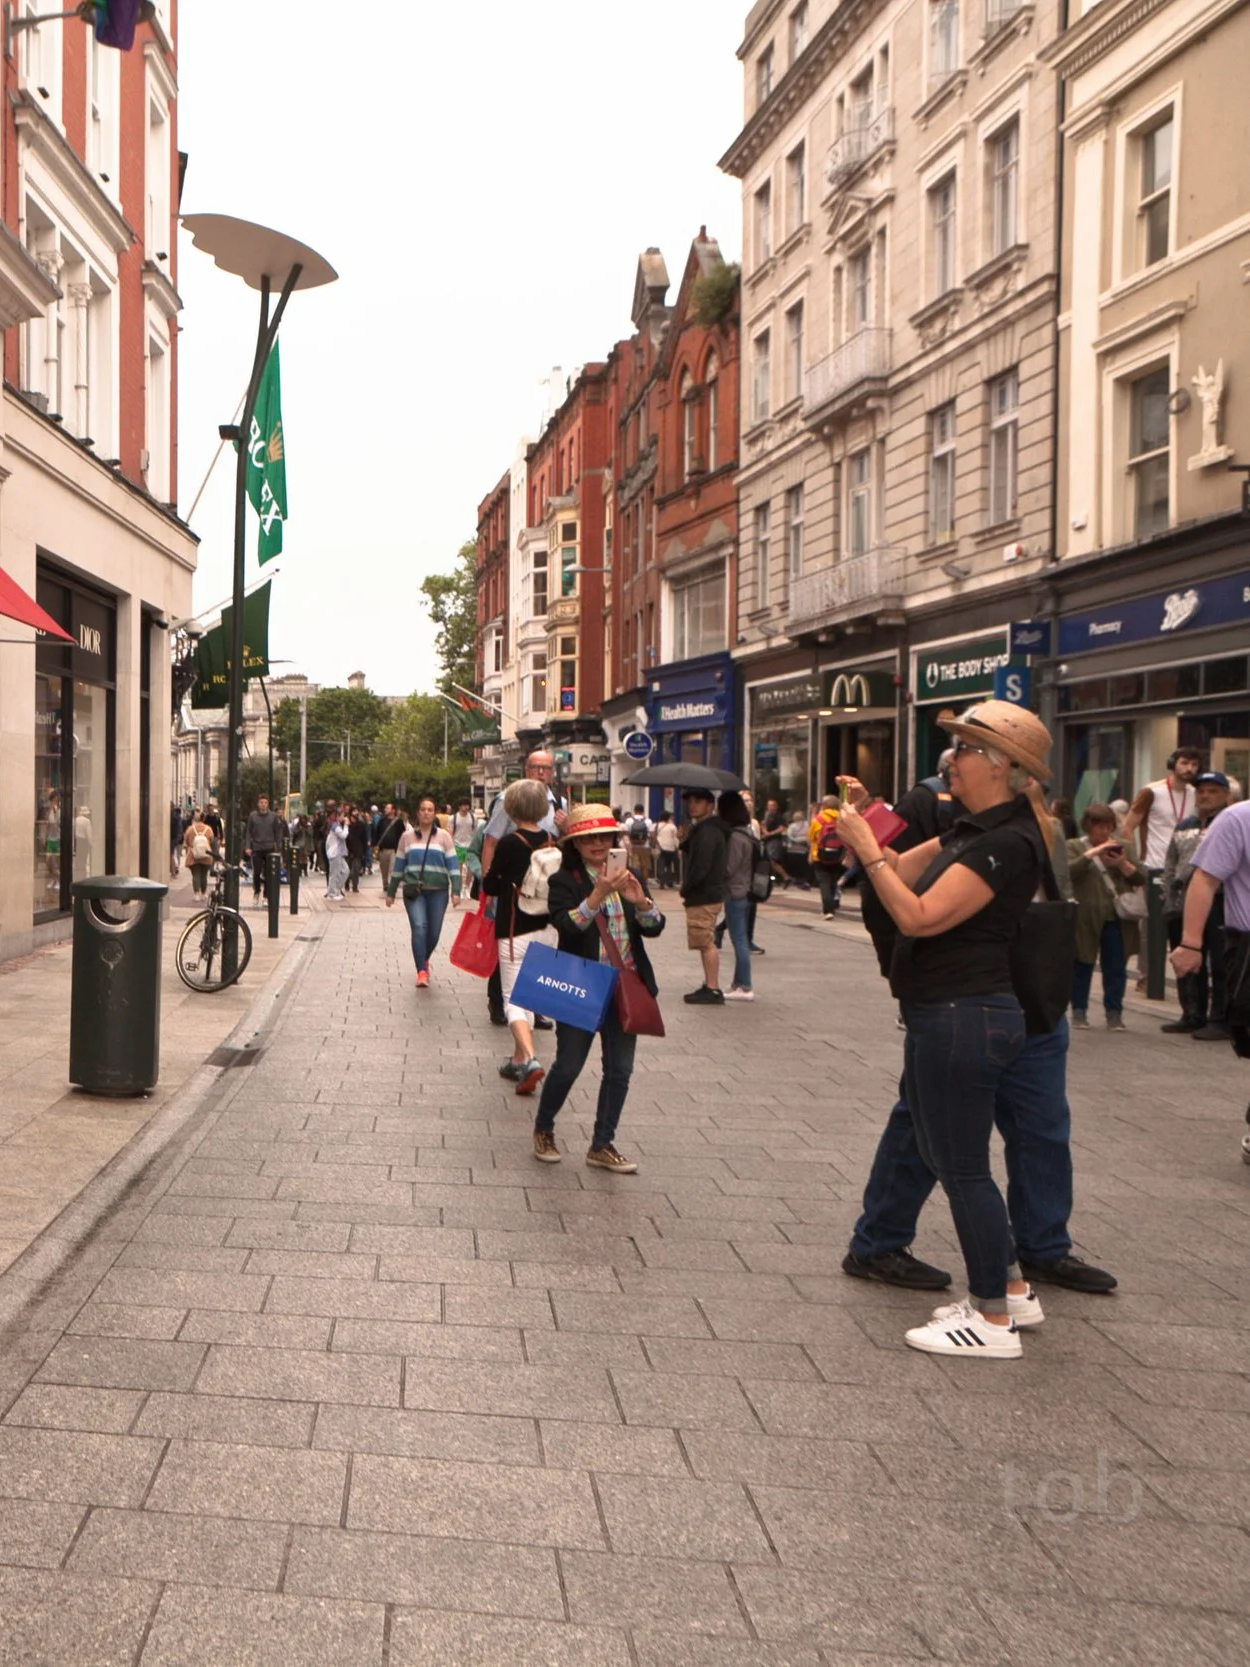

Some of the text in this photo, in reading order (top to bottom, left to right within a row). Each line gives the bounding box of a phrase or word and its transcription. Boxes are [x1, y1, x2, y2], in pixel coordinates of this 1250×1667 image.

[79, 623, 102, 656] DIOR
[940, 663, 957, 681] THE
[958, 659, 982, 678] BODY
[664, 702, 715, 720] Health Matters
[536, 975, 587, 999] ARNOTTS
